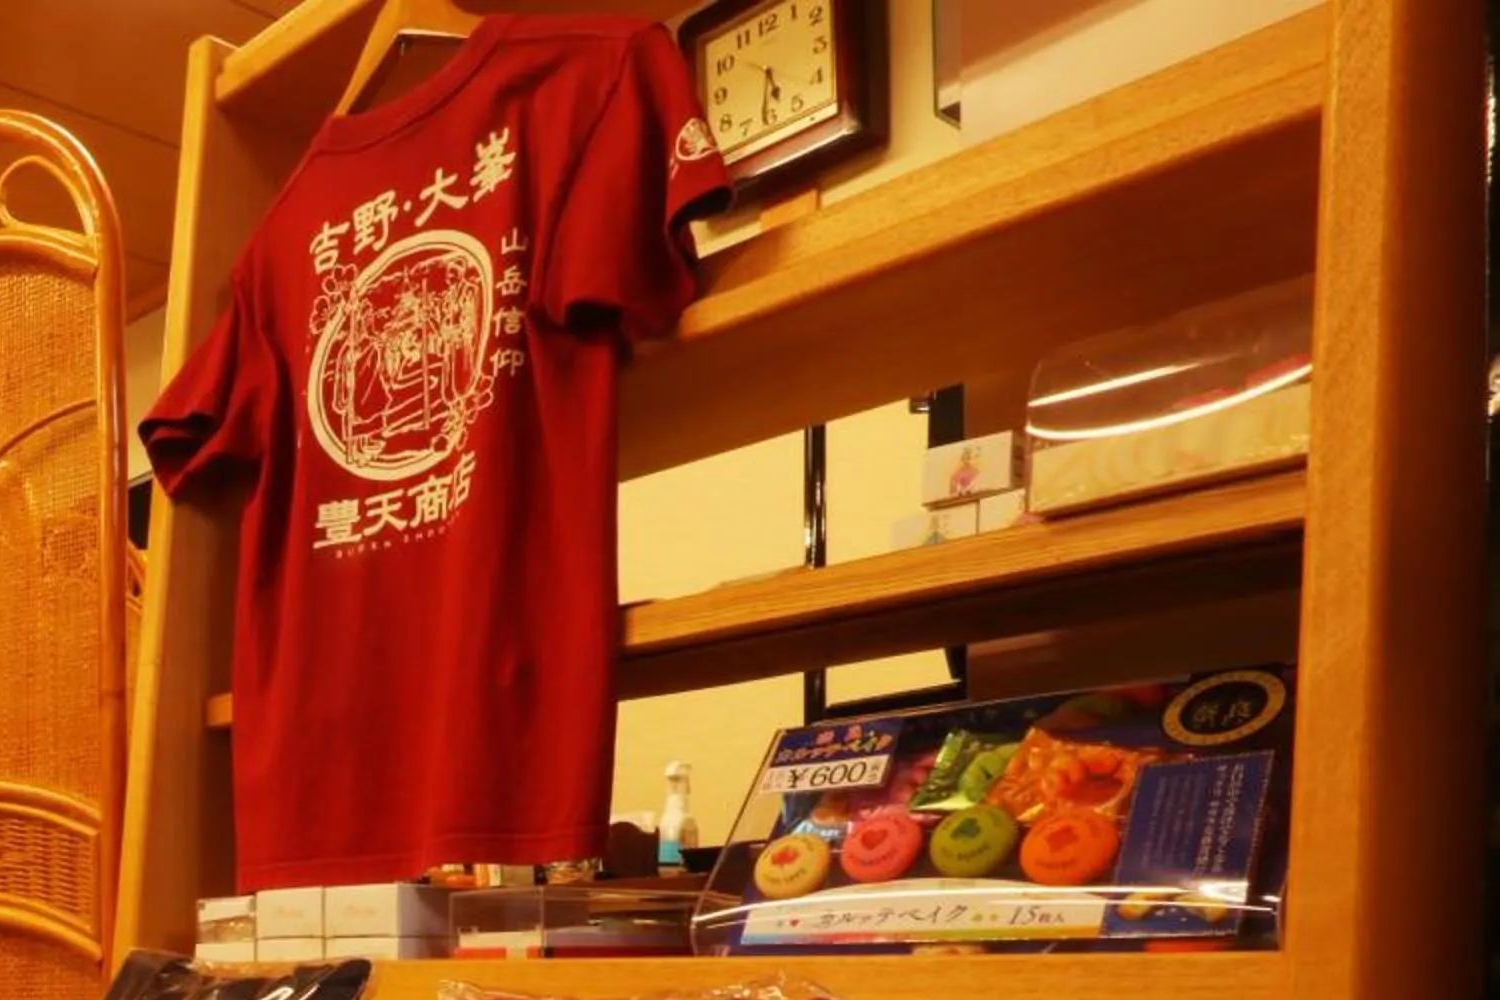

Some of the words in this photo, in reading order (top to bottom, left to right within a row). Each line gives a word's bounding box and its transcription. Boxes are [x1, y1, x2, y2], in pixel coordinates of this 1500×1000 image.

[789, 4, 798, 20] 1
[809, 6, 823, 26] 2
[758, 13, 778, 36] 12
[736, 29, 750, 50] 11
[813, 36, 827, 54] 3
[716, 55, 734, 75] 10
[809, 67, 823, 85] 4
[714, 87, 727, 105] 9
[791, 95, 804, 112] 5
[719, 114, 732, 132] 8
[740, 119, 753, 136] 7
[490, 227, 529, 378] 山岳信仰
[787, 761, 867, 789] ¥600
